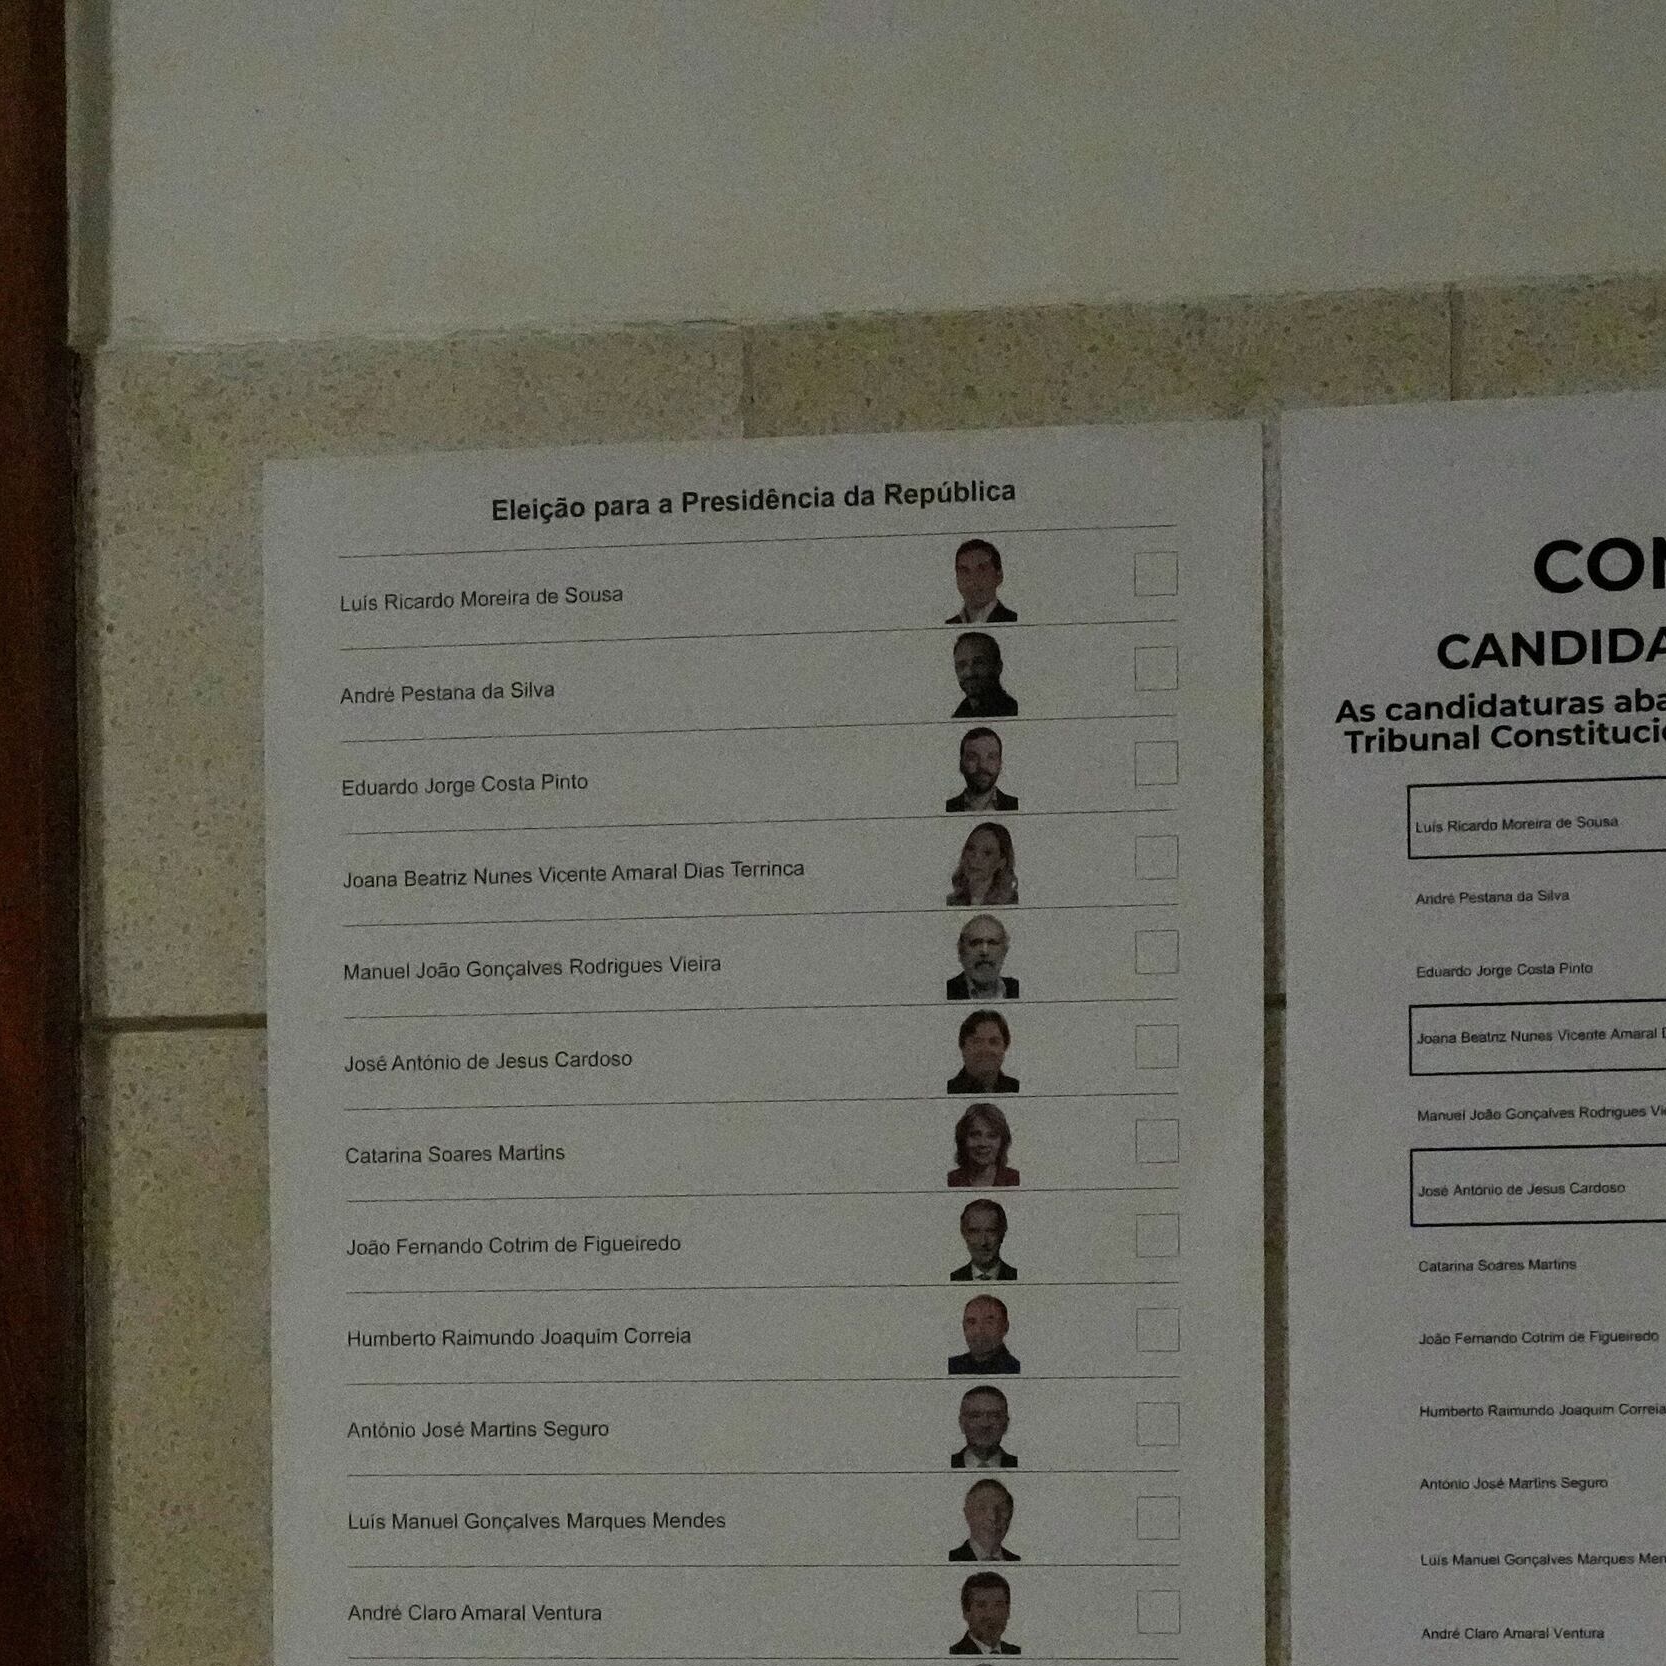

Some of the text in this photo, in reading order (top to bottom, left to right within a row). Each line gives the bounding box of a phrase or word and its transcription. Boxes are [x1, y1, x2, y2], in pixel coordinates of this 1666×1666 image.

[491, 478, 1016, 525] Eleição para a Presidência da República
[339, 584, 624, 614] Luís Ricardo Moreira de Sousa
[339, 679, 556, 705] André Pestana da Silva
[1335, 699, 1376, 725] As
[1385, 692, 1605, 723] candidaturas
[1345, 726, 1480, 754] Tribunal
[341, 771, 590, 799] Eduardo Jorge Costa Pinto
[342, 859, 806, 890] Joana Beatriz Nunes Vicente Amaral Dias Terrinca
[1415, 887, 1571, 907] André Pestana da Silva
[1415, 961, 1594, 981] Eduardo Jorge Costa Pinto
[344, 1143, 567, 1166] Catarina Soares Martins
[345, 1233, 682, 1258] João Fernando Cotrim de Figueiredo
[346, 1324, 692, 1350] Humberto Raimundo Joaquim Correia
[1418, 1405, 1485, 1419] Humberto
[1486, 1403, 1555, 1418] Raimundo
[1558, 1404, 1616, 1419] Joaquim
[347, 1509, 727, 1533] Luís Manuel Gonçalves Marques Mendes
[347, 1603, 603, 1623] André Claro Amaral Ventura
[1421, 1626, 1606, 1641] André Claro Amaral Ventura
